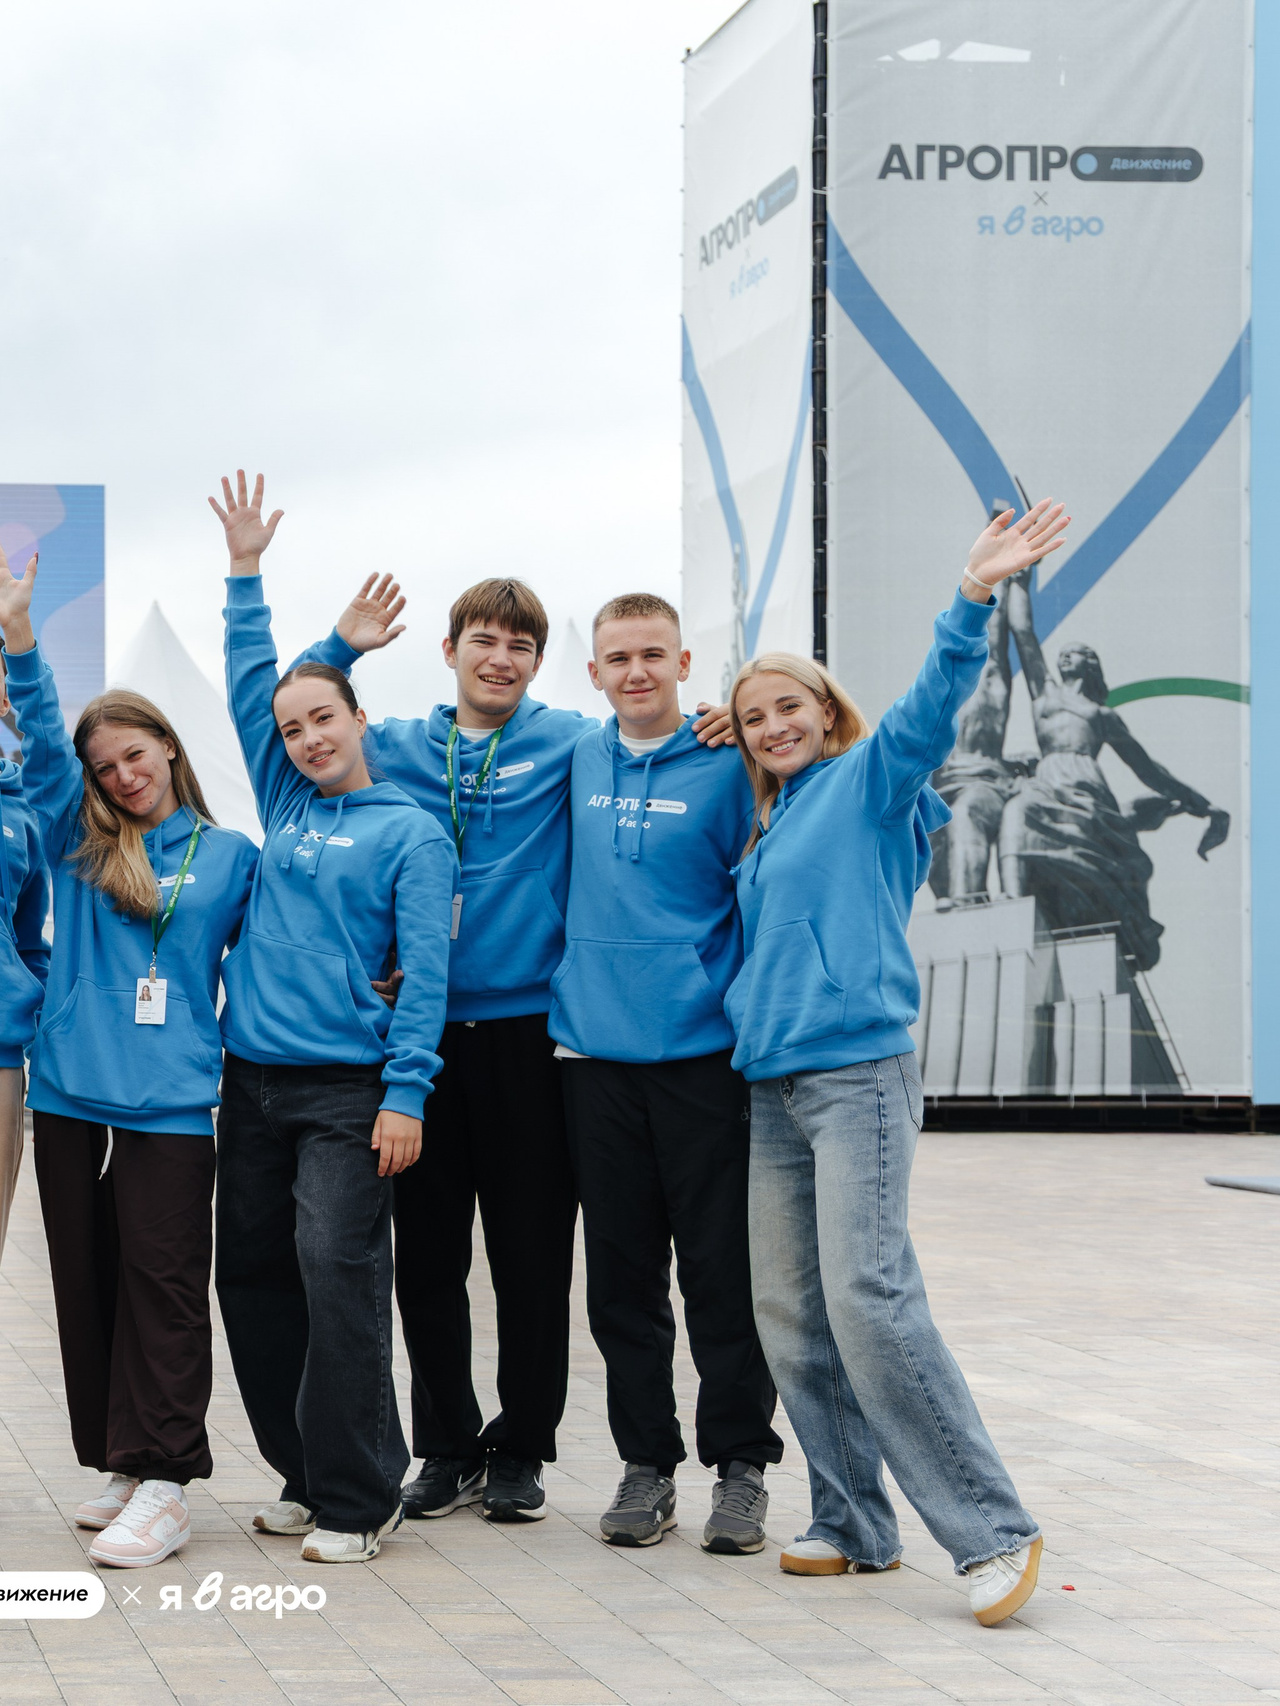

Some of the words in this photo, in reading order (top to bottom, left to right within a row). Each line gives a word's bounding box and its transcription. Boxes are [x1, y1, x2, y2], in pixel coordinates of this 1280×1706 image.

[1110, 156, 1192, 172] движение
[977, 214, 995, 236] я
[1031, 214, 1104, 243] агро
